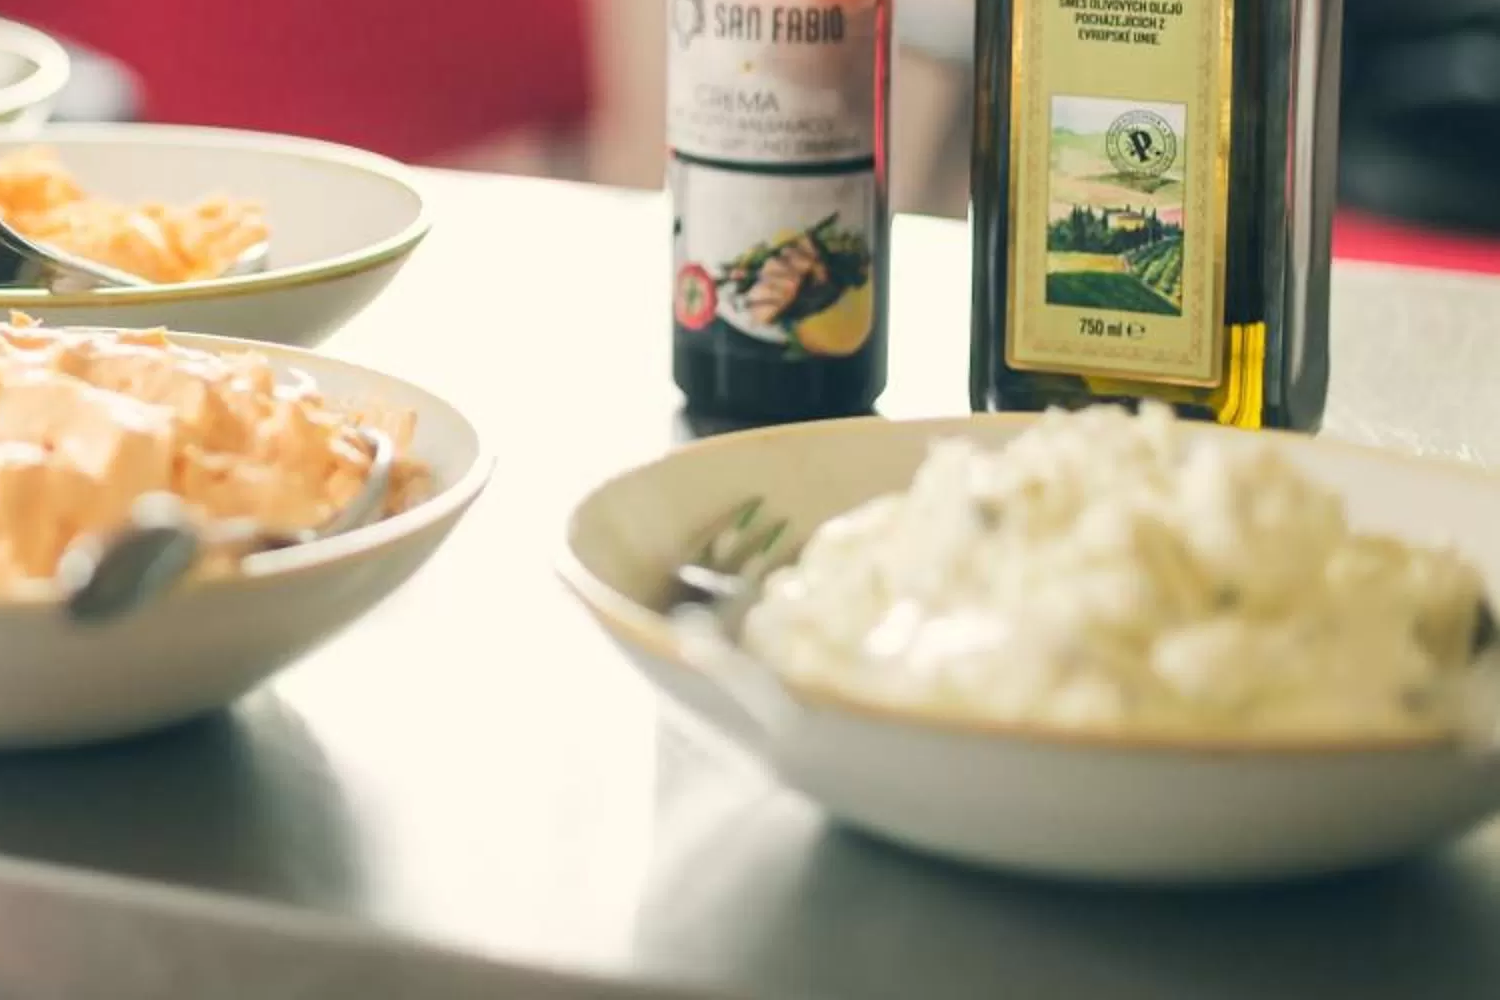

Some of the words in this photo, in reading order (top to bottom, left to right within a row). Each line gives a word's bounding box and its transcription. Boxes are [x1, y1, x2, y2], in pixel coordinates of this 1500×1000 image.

[714, 3, 761, 41] SAN
[772, 4, 845, 44] FABIO
[1079, 318, 1104, 337] 750
[1107, 320, 1123, 337] ml
